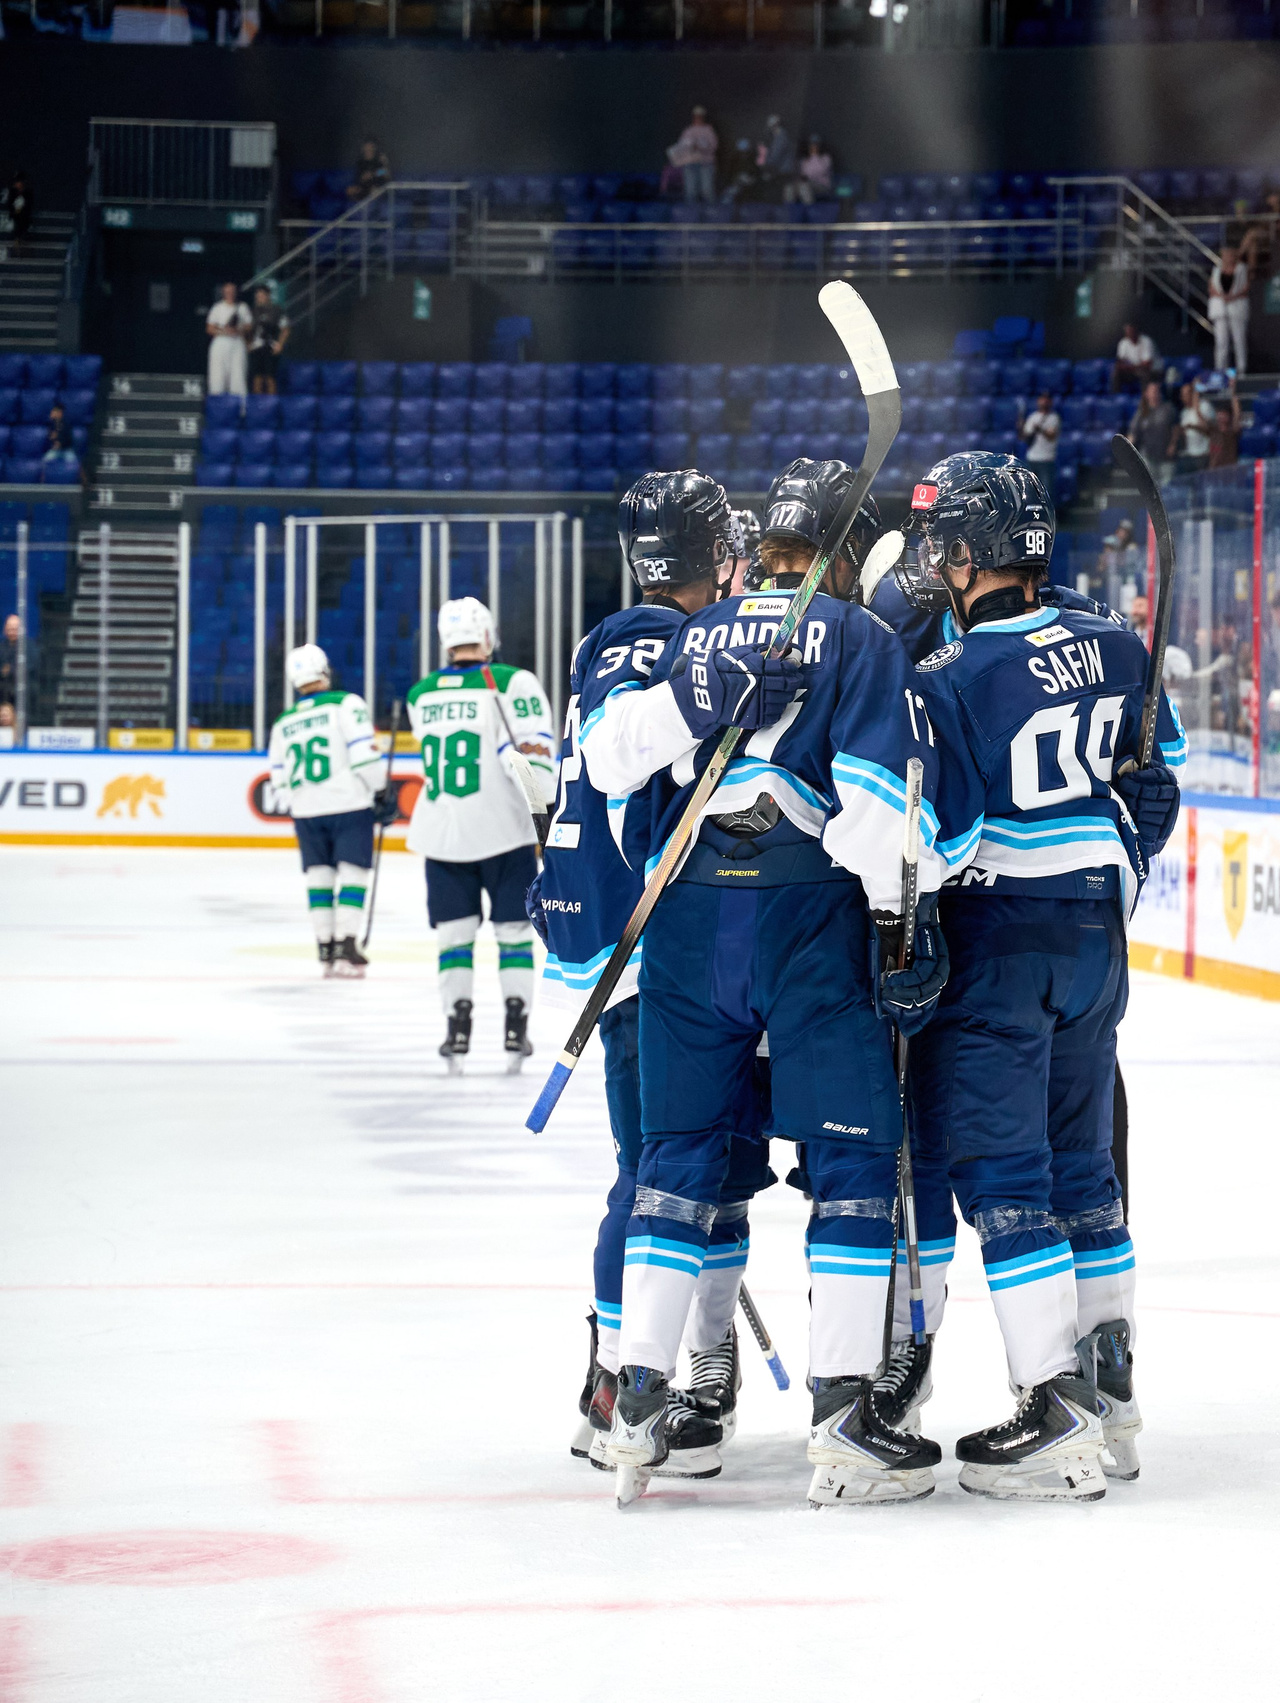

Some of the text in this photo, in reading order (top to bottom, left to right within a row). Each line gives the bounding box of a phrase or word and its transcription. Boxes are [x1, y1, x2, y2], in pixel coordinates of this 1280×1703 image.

[778, 504, 799, 527] 17
[1025, 531, 1045, 555] 98
[643, 559, 671, 581] 32
[683, 620, 827, 665] BONDR
[596, 638, 666, 679] 32
[1027, 638, 1105, 695] SAFIN
[421, 701, 478, 725] ZAYETS
[513, 696, 543, 719] 98
[904, 687, 935, 748] 17
[286, 735, 330, 790] 26
[421, 729, 481, 802] 98
[715, 869, 760, 878] SUPREME
[822, 1121, 870, 1136] BAUER
[871, 1436, 908, 1455] BAUER
